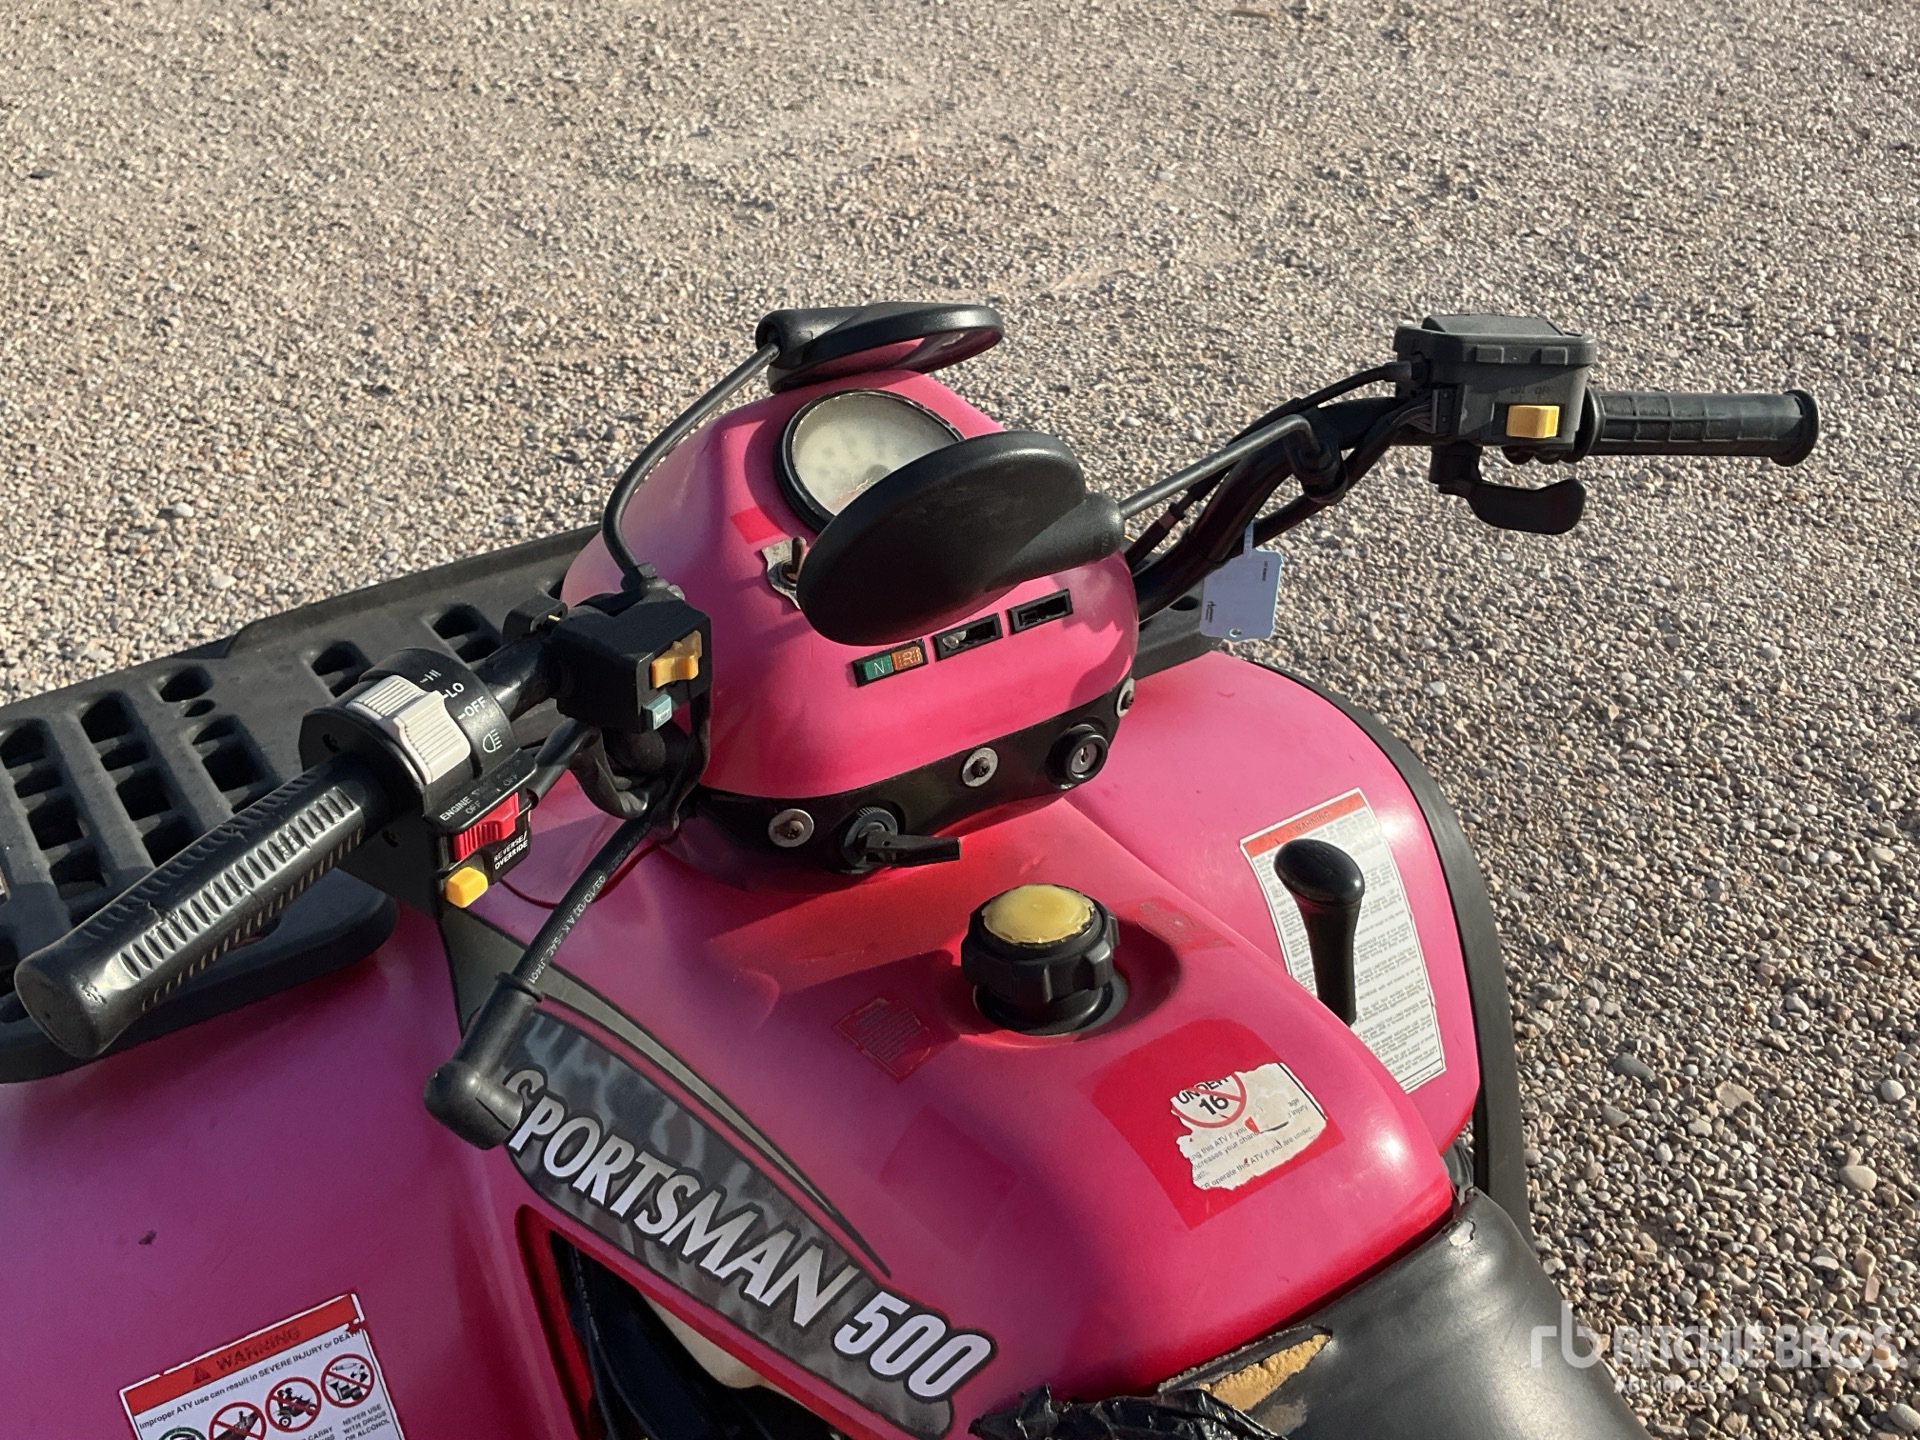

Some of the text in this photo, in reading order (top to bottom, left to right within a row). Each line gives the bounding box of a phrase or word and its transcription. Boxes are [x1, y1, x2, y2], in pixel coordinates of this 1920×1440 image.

[874, 659, 885, 676] N
[447, 682, 465, 699] LO
[464, 696, 487, 717] OFF
[439, 796, 473, 821] ENGINE
[465, 800, 481, 814] OFF
[494, 839, 529, 870] OVERRIDE
[1199, 1095, 1230, 1116] 16
[1214, 1135, 1229, 1147] ATV
[1288, 1097, 1300, 1108] age
[1211, 1168, 1238, 1188] operate
[1250, 1152, 1265, 1164] ATV
[1293, 1126, 1313, 1141] under
[1224, 1142, 1240, 1156] your
[501, 1069, 992, 1399] SPORTSMAN 500
[216, 1327, 301, 1371] WARNING
[176, 1400, 194, 1414] ATV
[193, 1395, 210, 1407] use
[210, 1388, 225, 1400] can
[226, 1378, 250, 1393] result
[258, 1358, 292, 1378] SEVERE
[293, 1345, 323, 1363] INJURY
[342, 1403, 383, 1426] NEVER USE
[343, 1410, 387, 1435] WITH DRUGS
[357, 1419, 391, 1438] ALCOHOL
